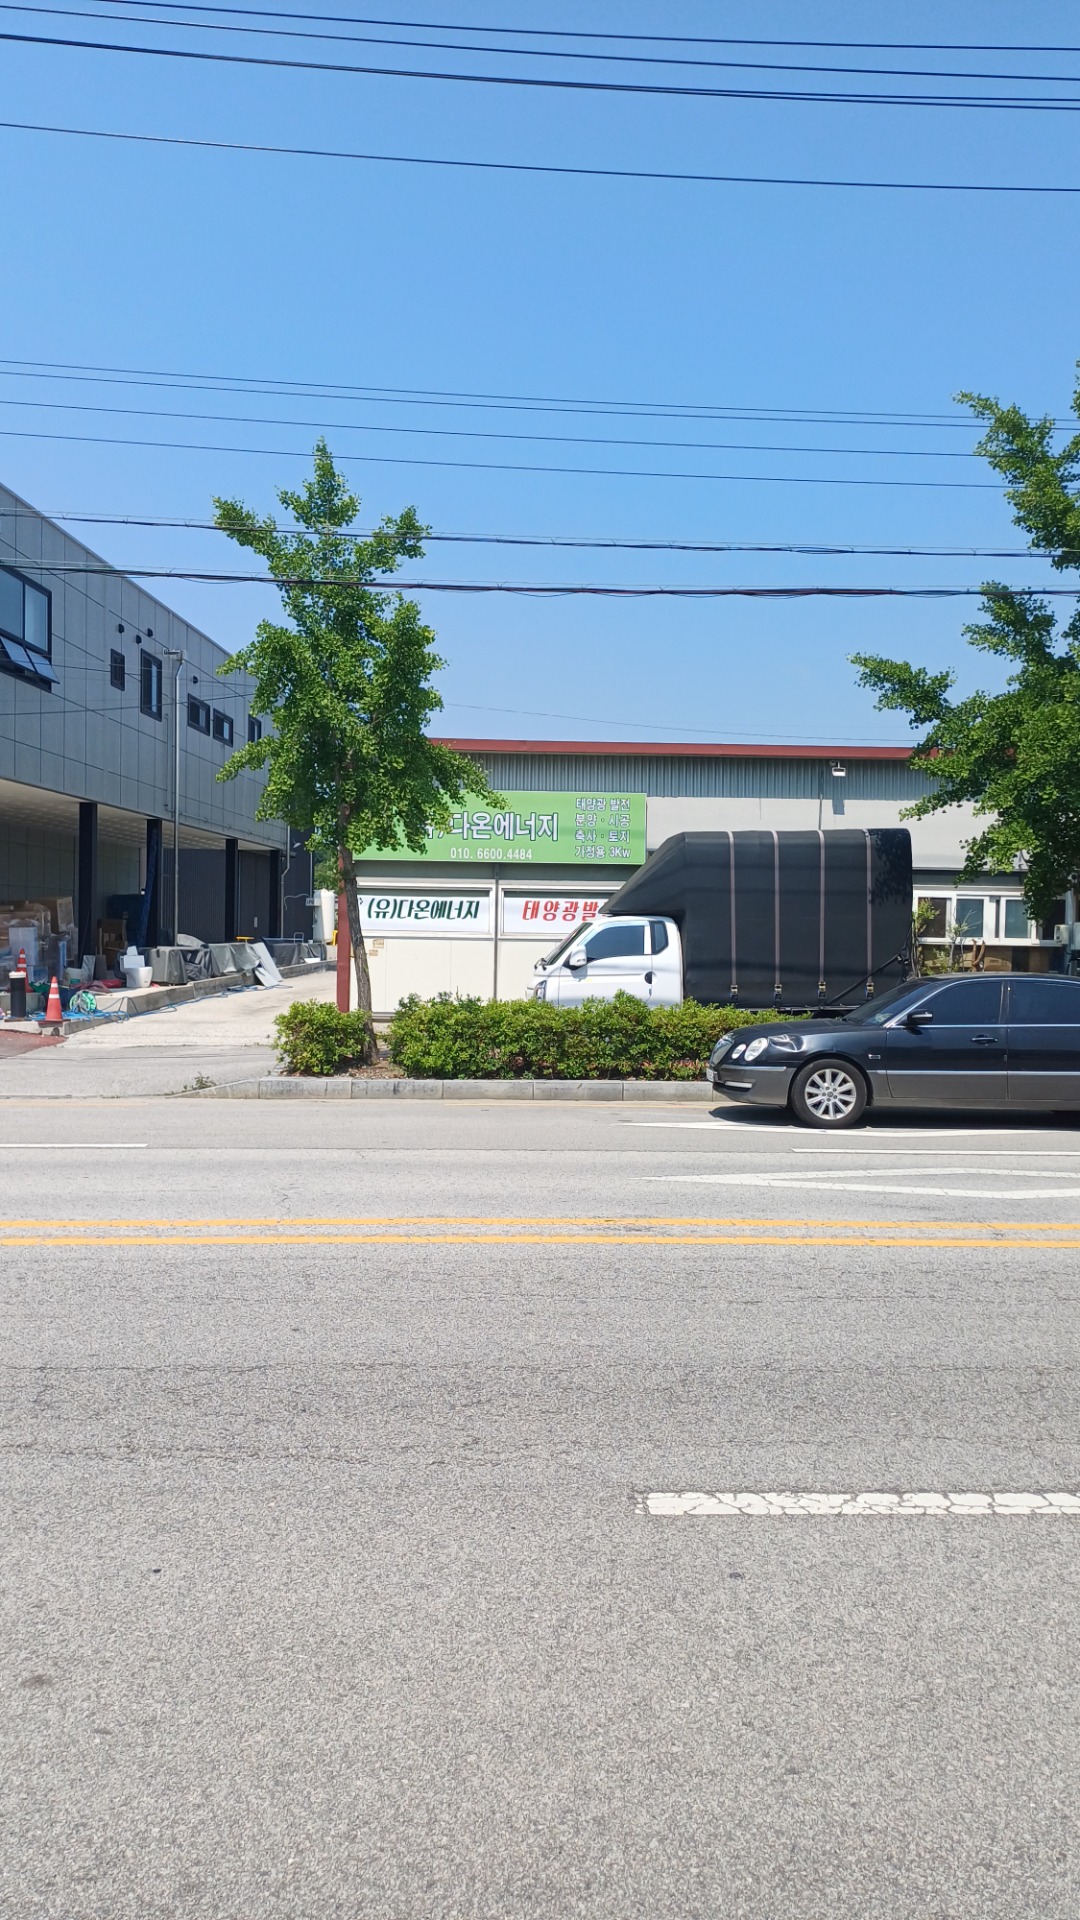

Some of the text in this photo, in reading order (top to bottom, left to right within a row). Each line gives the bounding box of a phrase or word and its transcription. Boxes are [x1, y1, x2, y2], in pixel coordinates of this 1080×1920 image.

[576, 798, 630, 811] 태양광 발전
[575, 845, 606, 859] 가정용
[367, 898, 480, 920] (유)다온에너지
